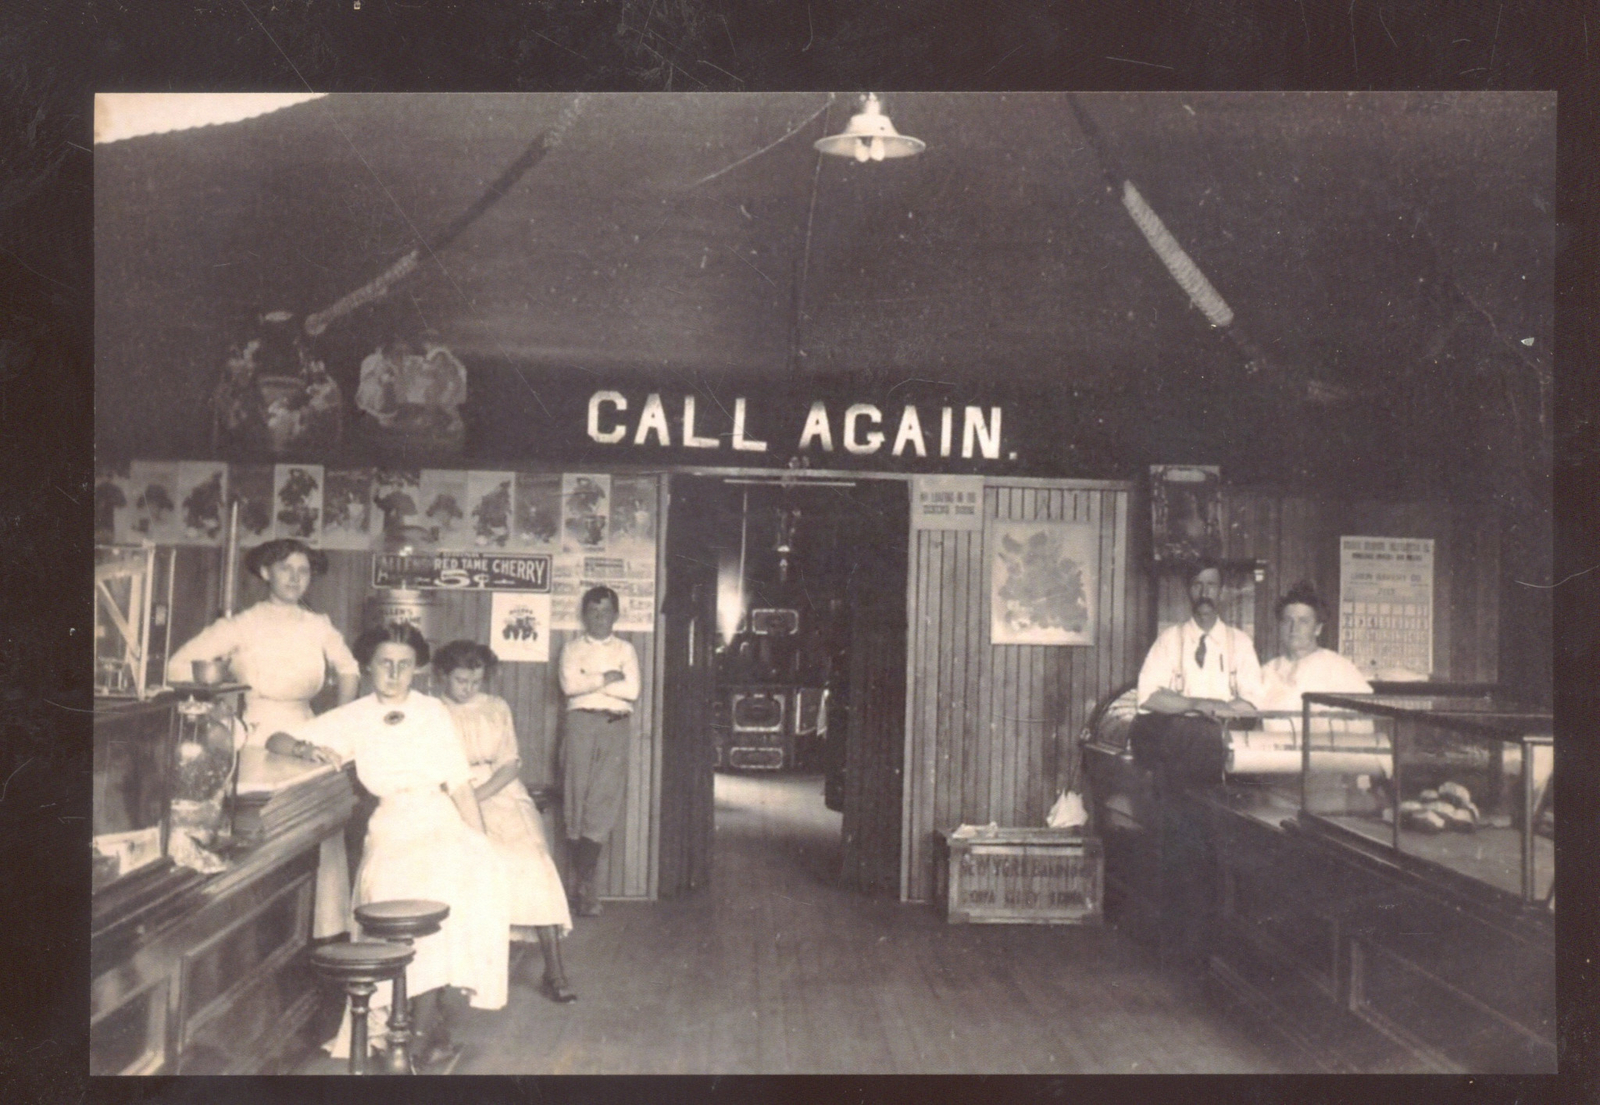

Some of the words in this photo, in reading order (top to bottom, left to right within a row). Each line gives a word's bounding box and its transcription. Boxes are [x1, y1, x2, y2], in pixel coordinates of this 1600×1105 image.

[587, 390, 767, 451] CALL
[798, 400, 1017, 460] AGAIN.
[434, 558, 459, 570] RED
[462, 558, 489, 571] TAME
[492, 559, 545, 585] CHERRY
